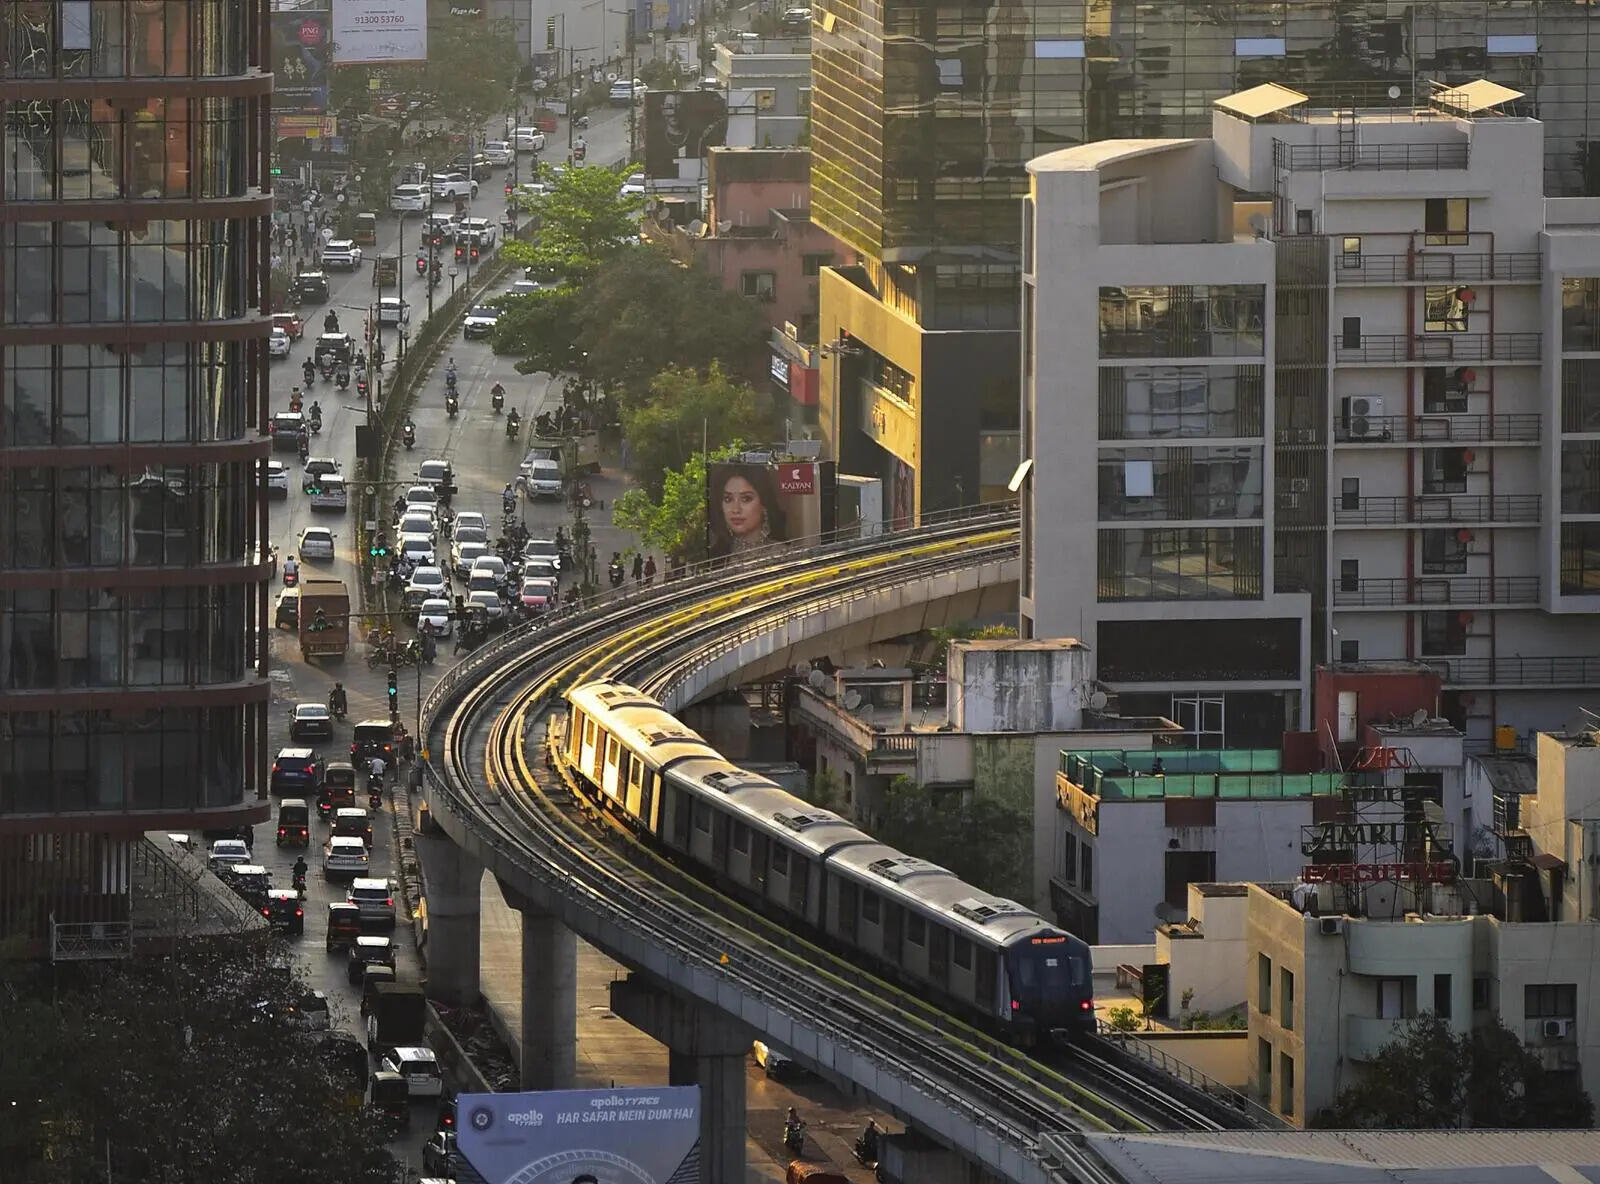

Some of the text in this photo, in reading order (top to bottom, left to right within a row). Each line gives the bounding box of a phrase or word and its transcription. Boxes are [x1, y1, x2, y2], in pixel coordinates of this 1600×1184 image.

[354, 15, 405, 24] 91300 53760
[302, 27, 319, 35] PNG
[1301, 822, 1457, 857] AMRIA
[591, 1096, 660, 1109] apollo TYRES
[508, 1110, 543, 1124] apollo
[556, 1108, 694, 1124] HAR SAFAR MEIN DUM HAI
